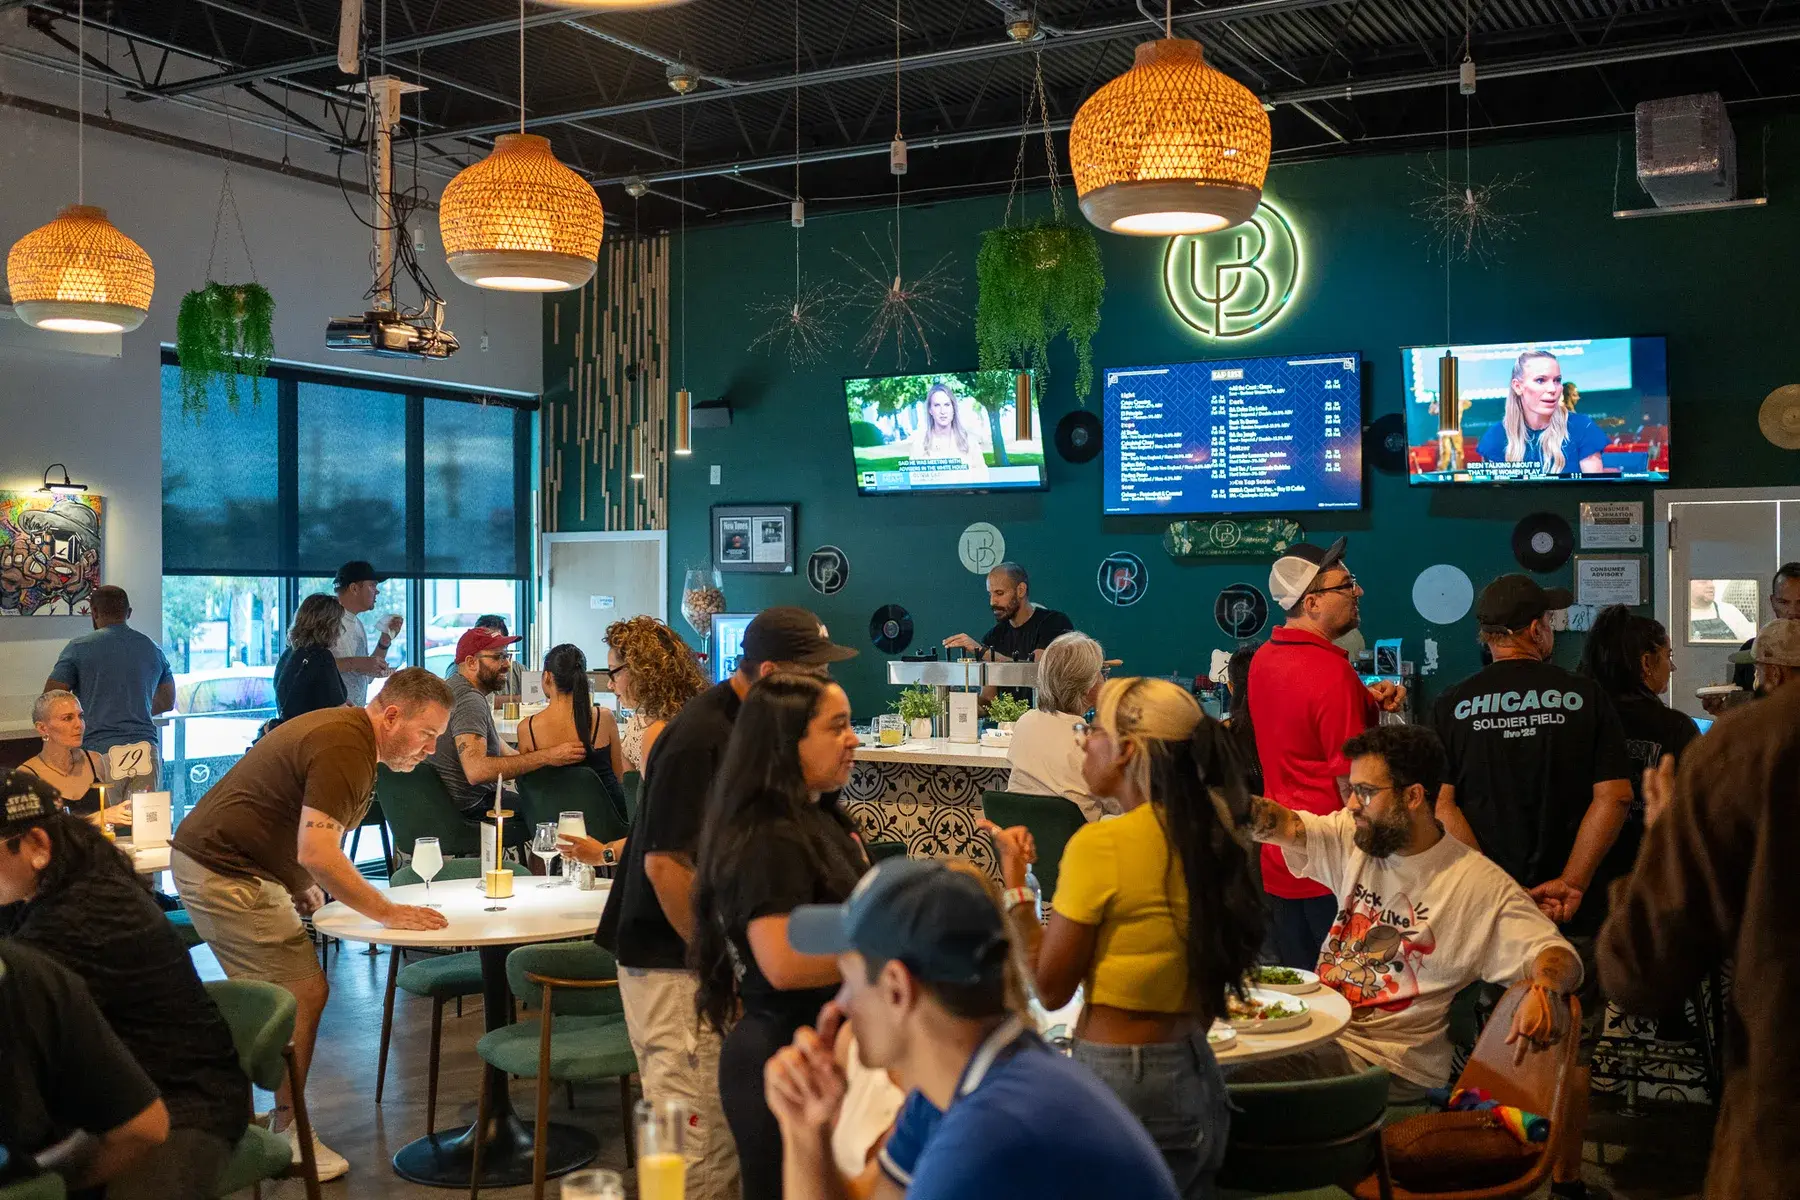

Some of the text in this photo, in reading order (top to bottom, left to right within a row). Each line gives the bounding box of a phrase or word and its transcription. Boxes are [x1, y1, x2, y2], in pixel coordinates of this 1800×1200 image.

[1572, 611, 1585, 624] 18
[1454, 689, 1584, 720] CHICAGO
[1472, 713, 1566, 731] SOLDIER FIELD
[1503, 730, 1521, 739] live
[118, 748, 143, 770] 19
